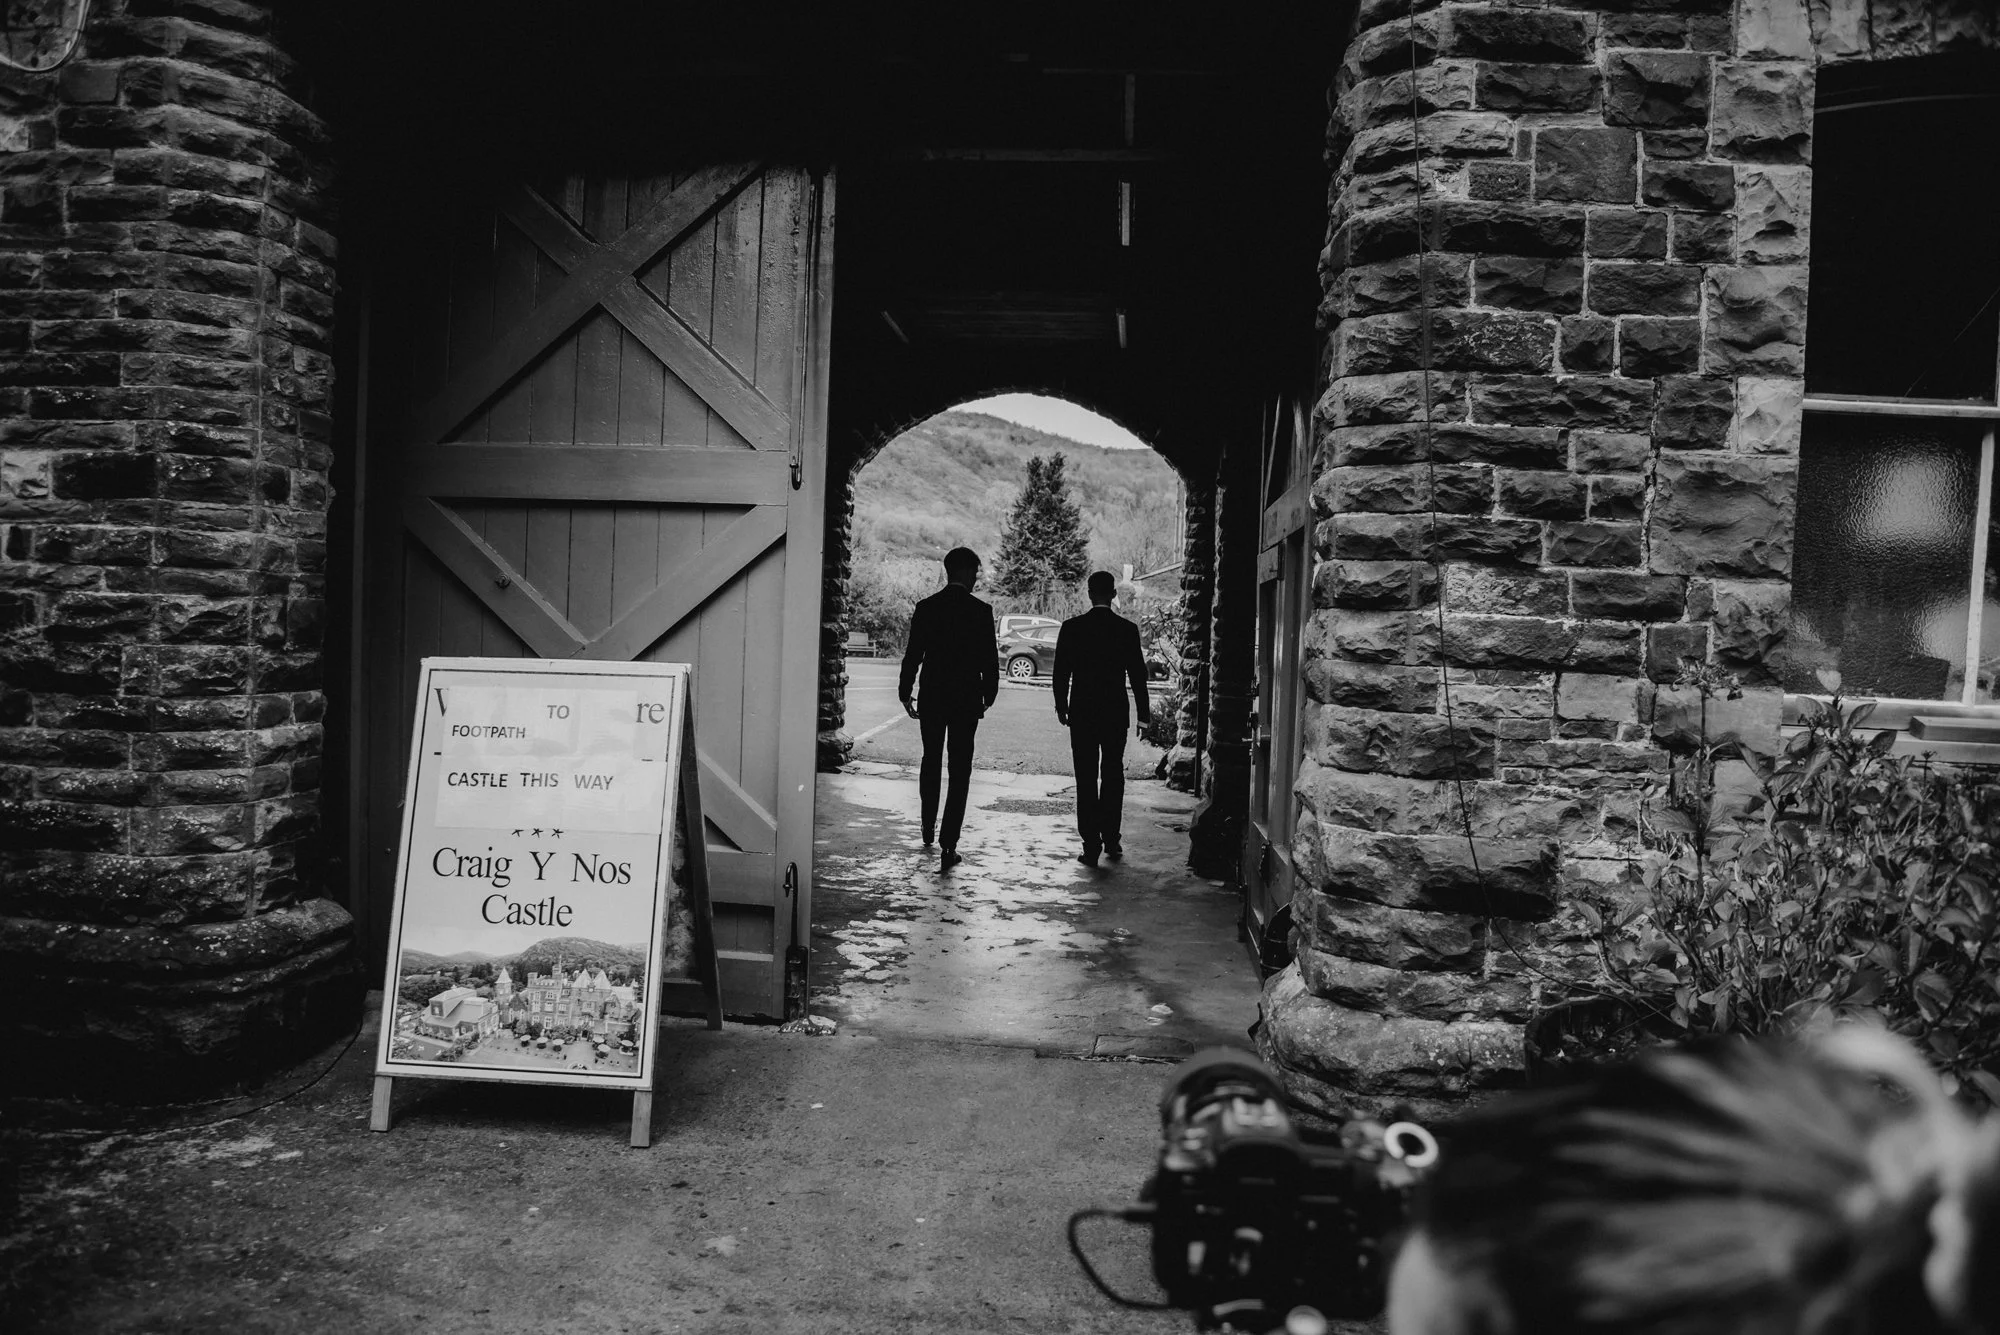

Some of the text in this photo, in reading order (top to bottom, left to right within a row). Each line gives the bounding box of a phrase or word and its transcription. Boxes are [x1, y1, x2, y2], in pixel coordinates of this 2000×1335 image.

[547, 705, 570, 720] TO
[452, 724, 526, 739] FOOTPATH
[447, 771, 614, 790] CASTLE THIS WAY
[432, 846, 632, 888] Craig Y Nos
[481, 893, 573, 927] Castle
